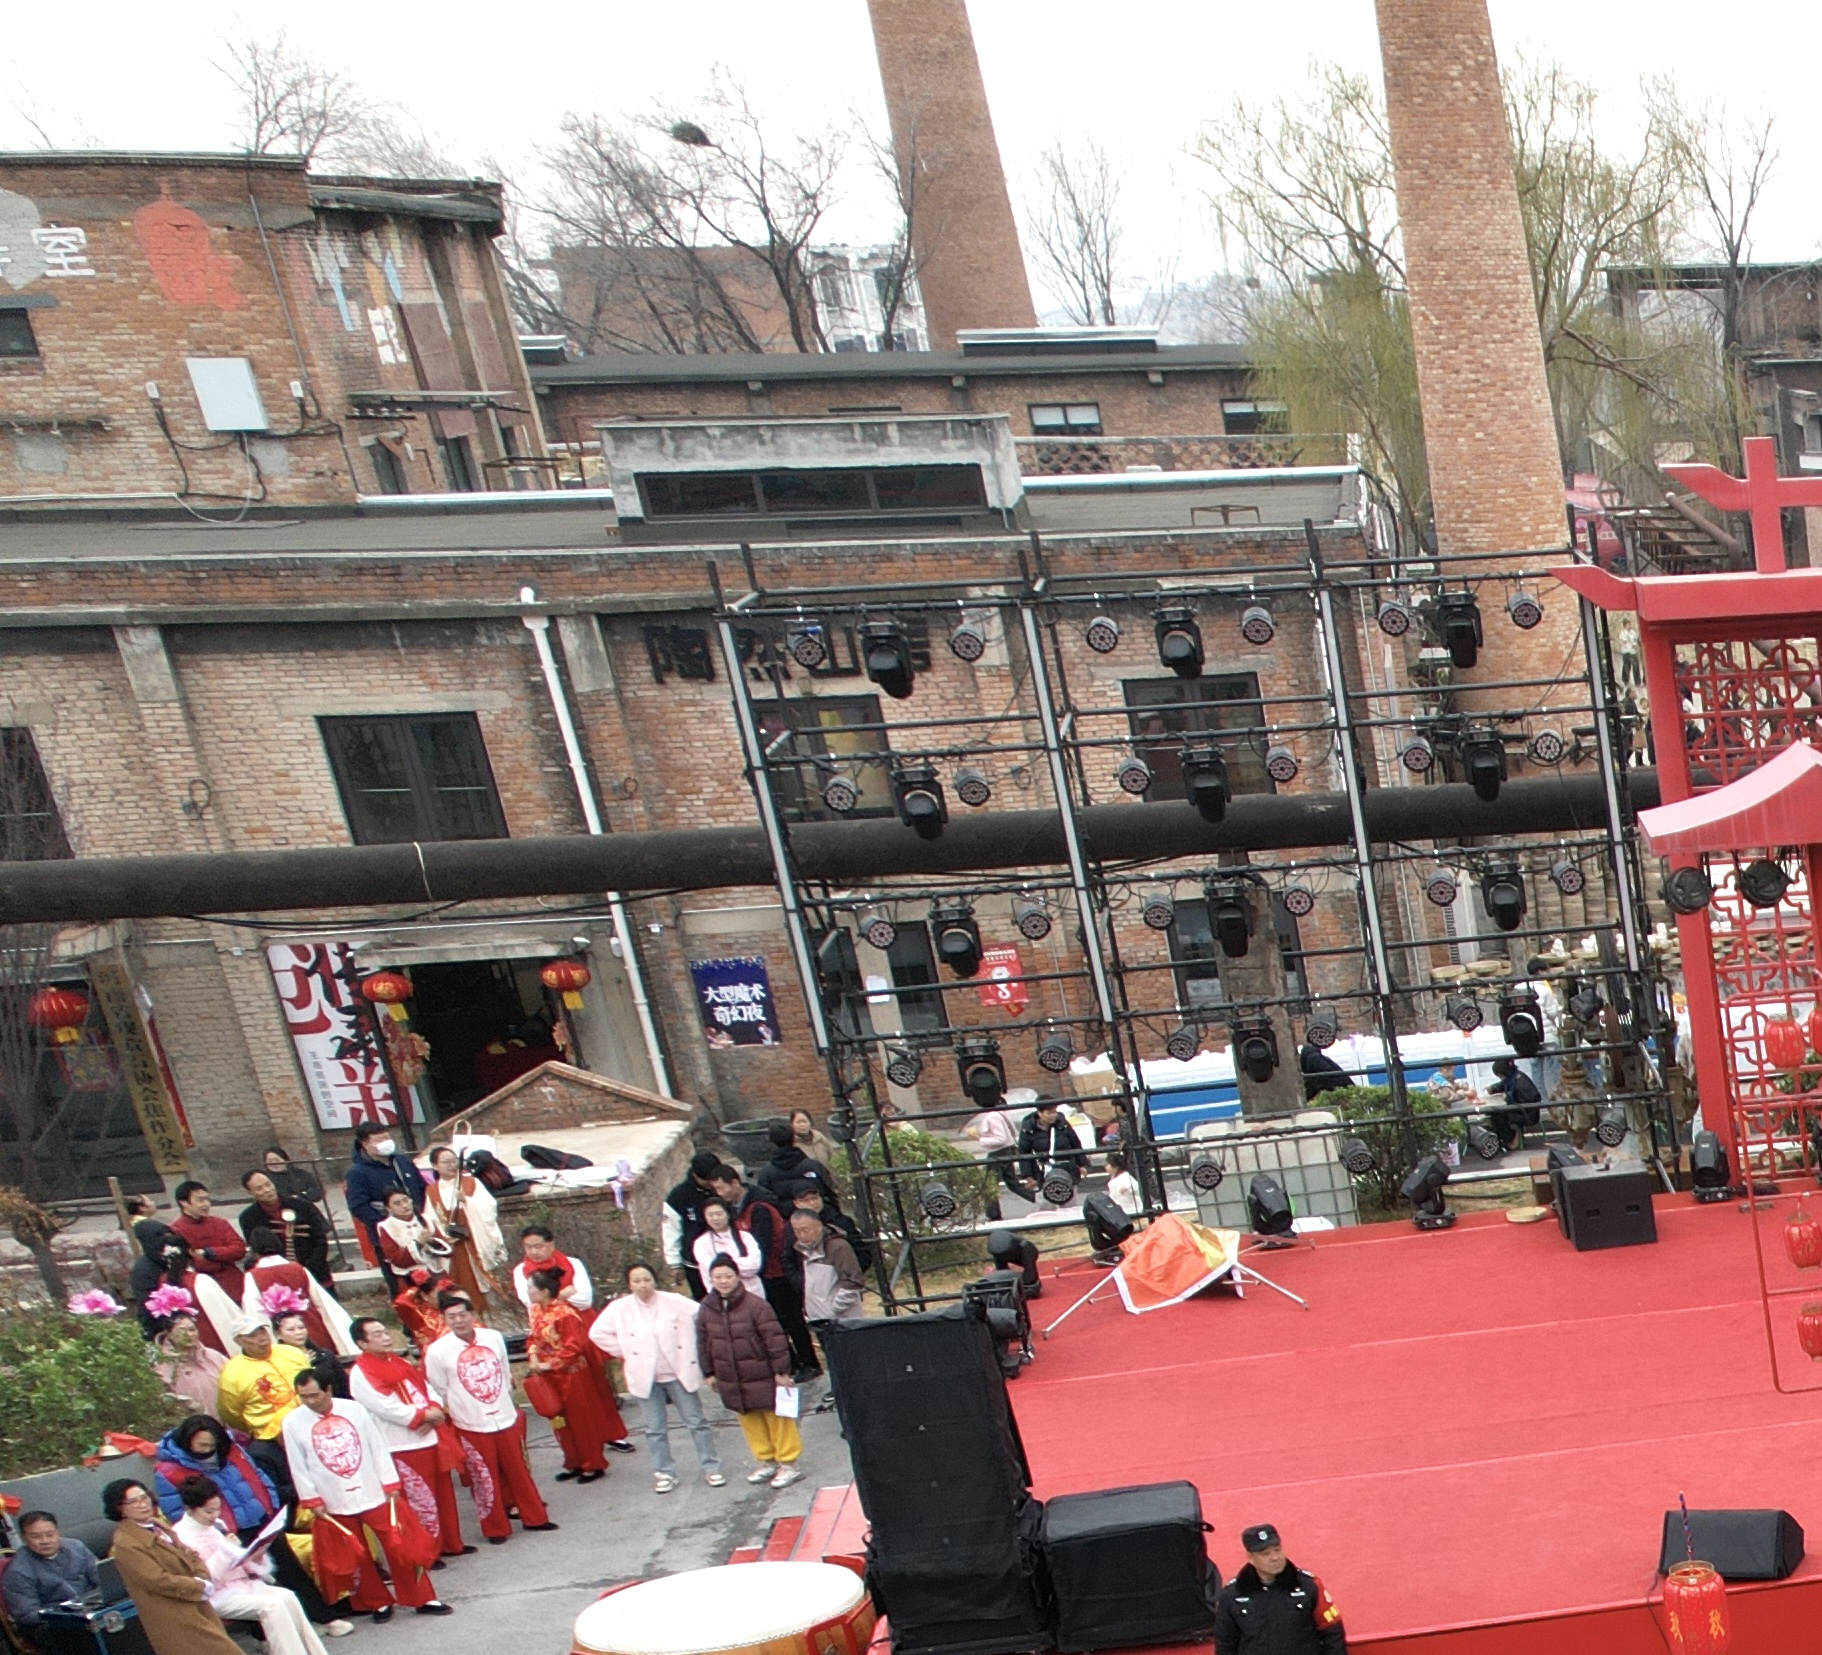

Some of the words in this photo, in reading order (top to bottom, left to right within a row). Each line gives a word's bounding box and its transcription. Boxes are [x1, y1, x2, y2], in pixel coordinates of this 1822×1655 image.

[702, 982, 766, 1005] 大型魔术
[713, 1002, 767, 1026] 奇幻夜
